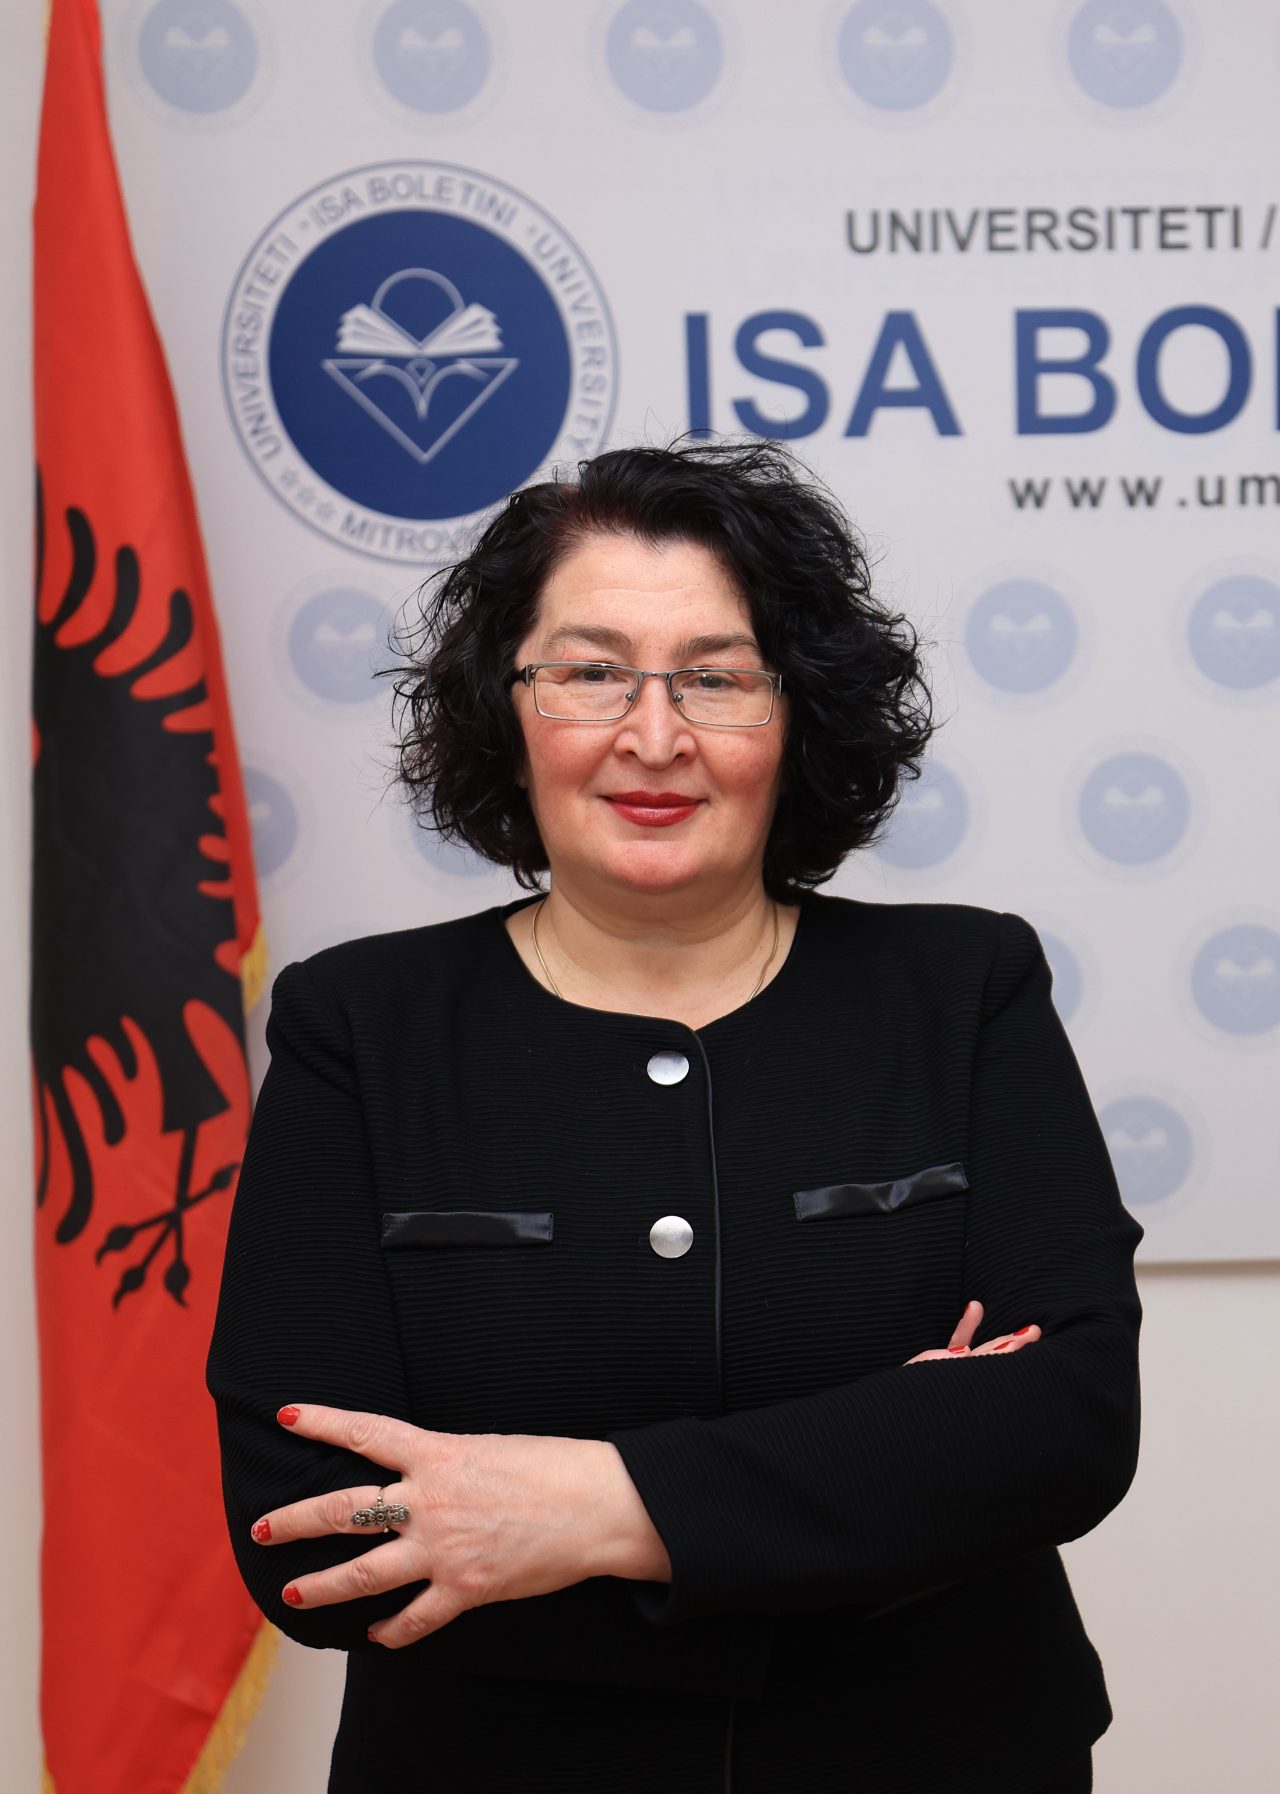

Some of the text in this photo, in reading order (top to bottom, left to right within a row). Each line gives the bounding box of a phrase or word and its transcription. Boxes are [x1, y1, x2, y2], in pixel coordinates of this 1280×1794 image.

[845, 205, 1243, 255] UNIVERSITETI
[232, 173, 519, 462] UNIVERSITETI ISA BOLETINI
[683, 308, 965, 441] ISA
